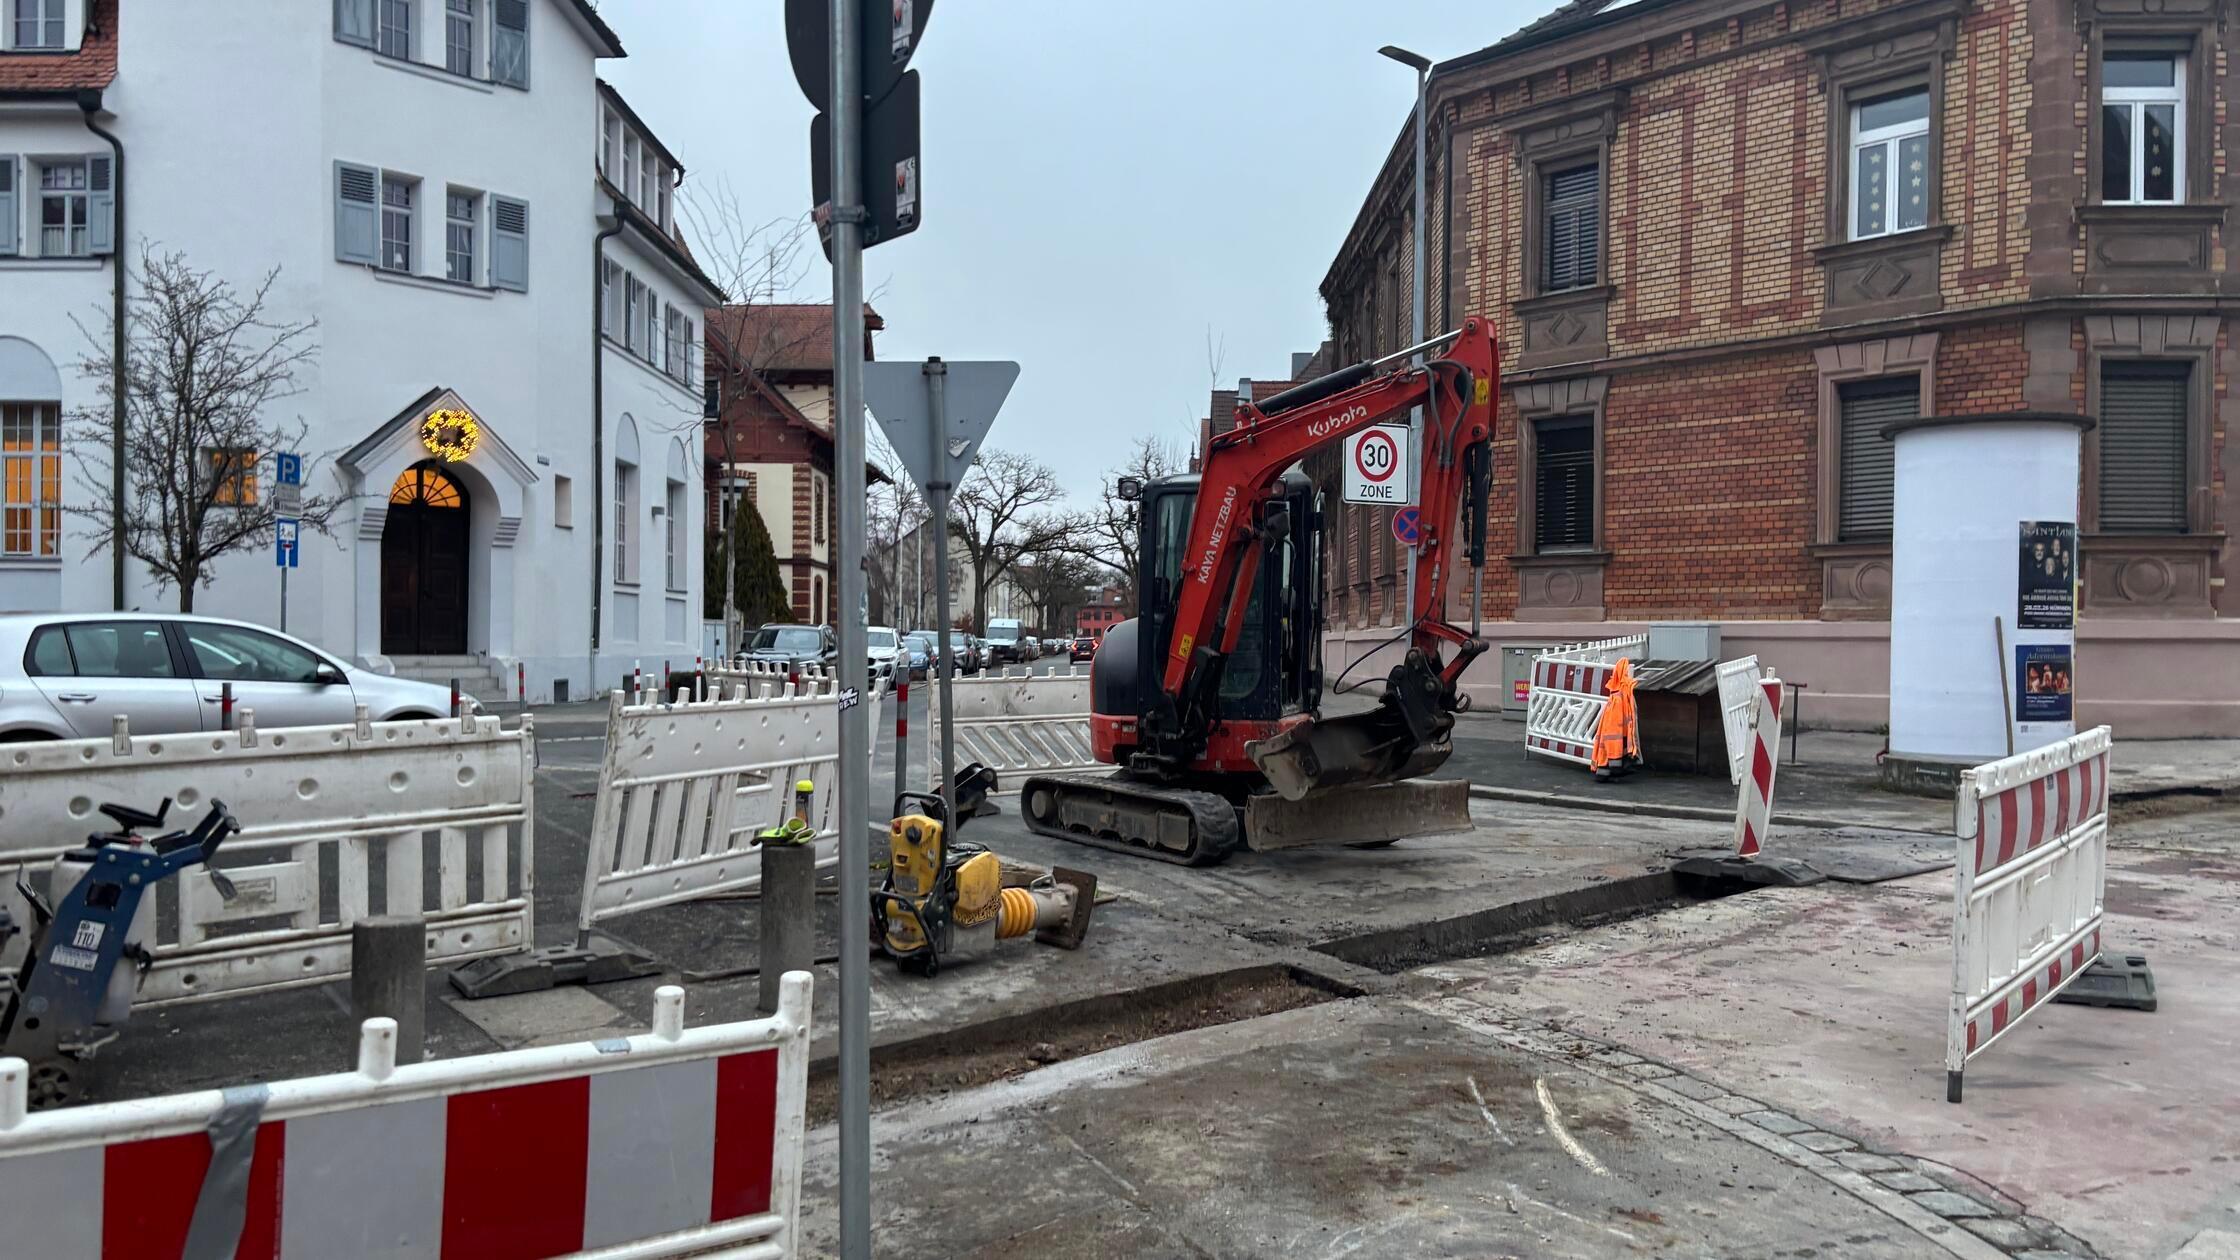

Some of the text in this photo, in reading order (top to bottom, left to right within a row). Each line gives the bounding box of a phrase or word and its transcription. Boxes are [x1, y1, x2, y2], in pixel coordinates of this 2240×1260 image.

[1307, 405, 1368, 437] Kubota
[1364, 443, 1389, 468] 30
[282, 456, 295, 482] P
[1360, 484, 1393, 499] ZONE
[1198, 486, 1237, 584] KAYA NETZBAU
[77, 931, 95, 946] 110
